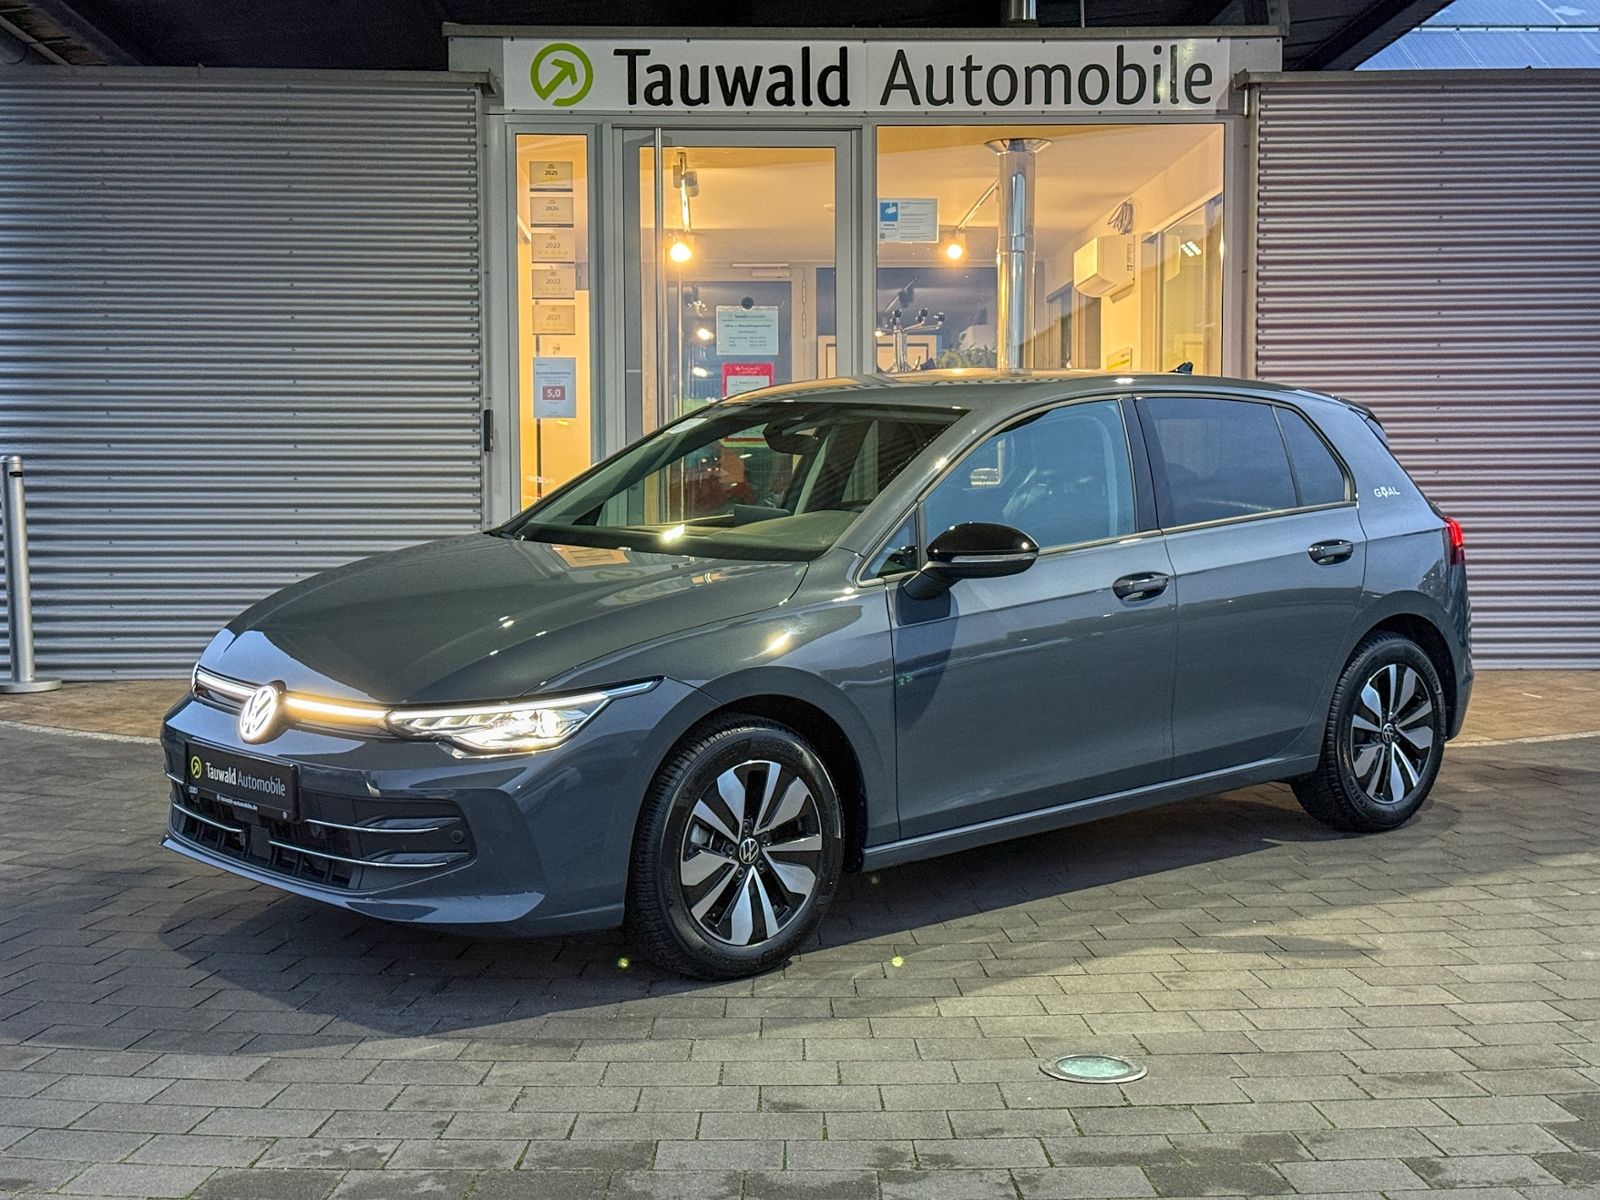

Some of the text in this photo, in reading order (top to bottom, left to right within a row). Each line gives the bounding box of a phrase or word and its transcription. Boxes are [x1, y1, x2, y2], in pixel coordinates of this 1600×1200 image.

[613, 44, 1213, 107] Tauwald Automobile
[1373, 486, 1401, 498] GOAL
[206, 763, 286, 797] Tauwald Automobile
